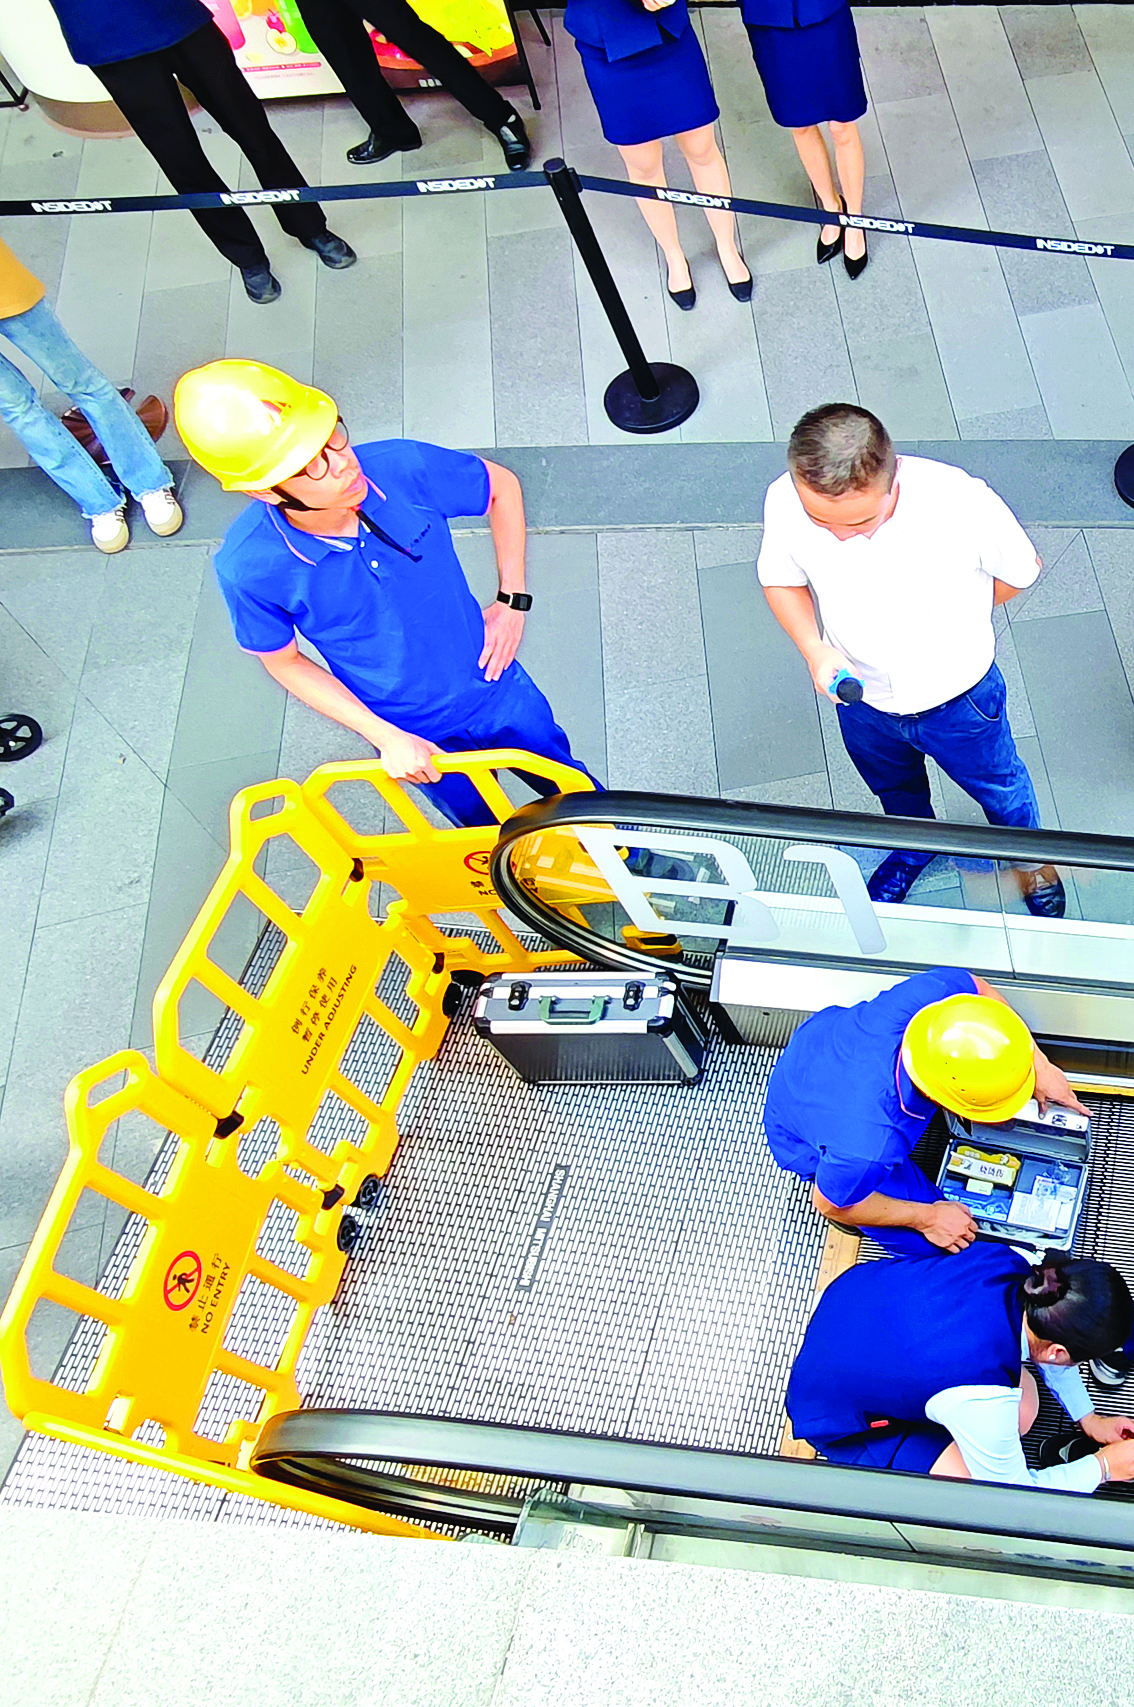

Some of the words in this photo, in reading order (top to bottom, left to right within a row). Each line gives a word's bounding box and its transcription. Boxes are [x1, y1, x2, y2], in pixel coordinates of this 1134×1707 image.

[573, 826, 887, 955] B1
[301, 976, 338, 1043] 暂停使用
[301, 1032, 326, 1075] UNDER
[324, 964, 357, 1031] ADJUSTING
[540, 1169, 566, 1222] SHANGHAI
[188, 1252, 223, 1332] 禁止通行
[519, 1227, 548, 1286] MITSUBISHI
[201, 1312, 214, 1334] NO
[210, 1262, 231, 1308] ENTRY
